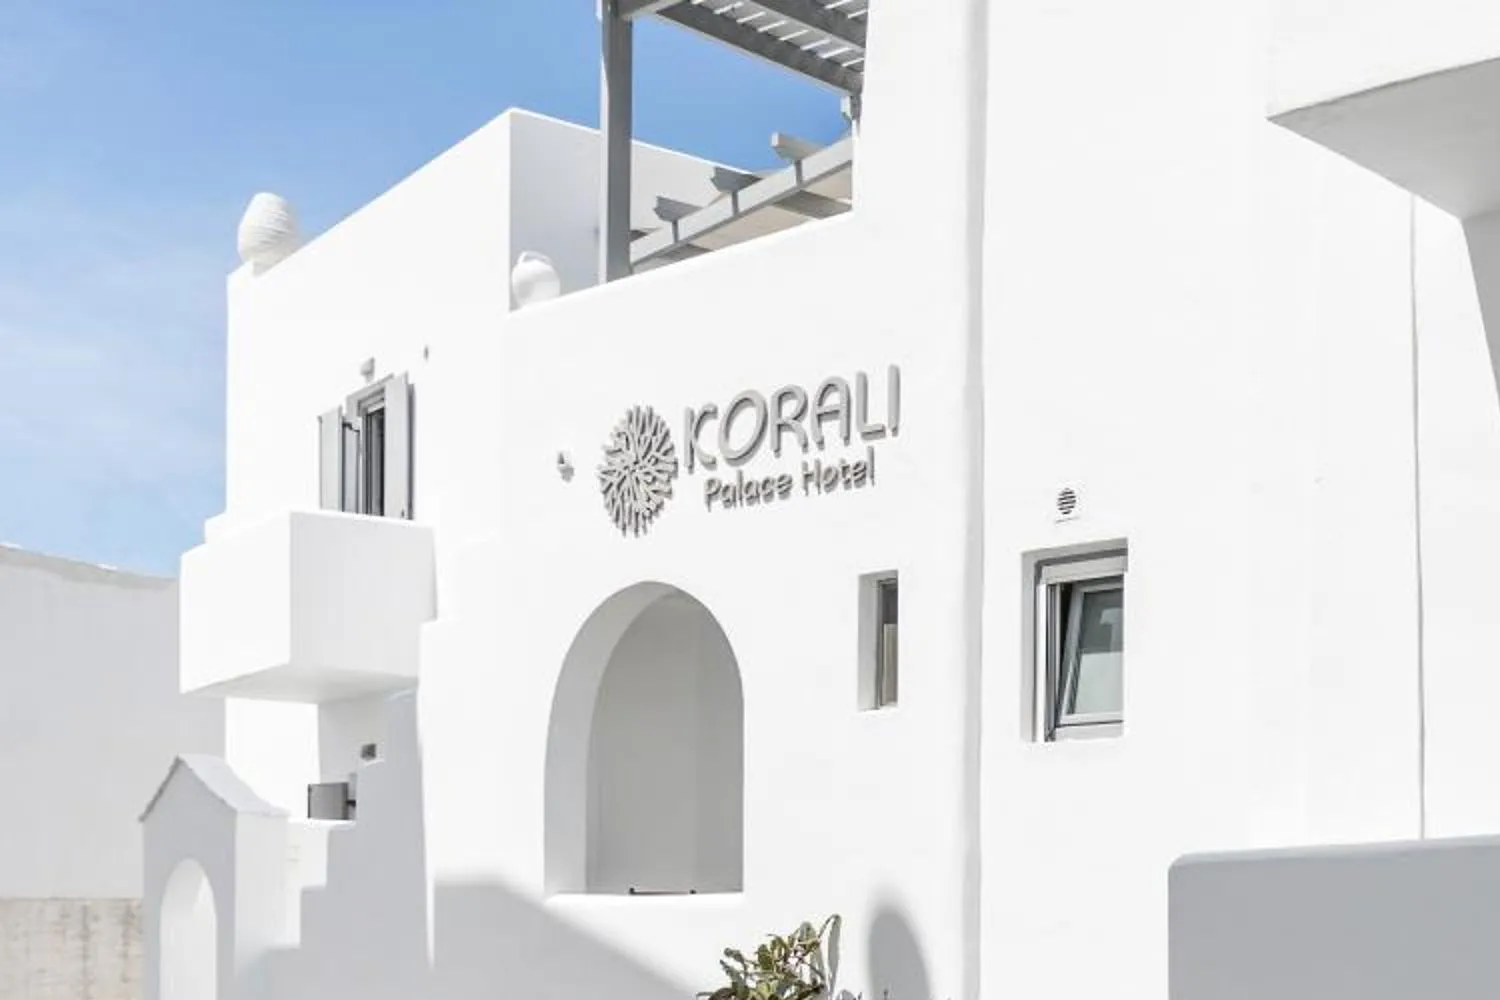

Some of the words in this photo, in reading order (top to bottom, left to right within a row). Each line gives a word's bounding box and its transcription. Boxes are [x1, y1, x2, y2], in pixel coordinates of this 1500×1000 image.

[684, 364, 901, 475] KORALI
[705, 470, 793, 512] Palace
[802, 446, 875, 496] Hotel
